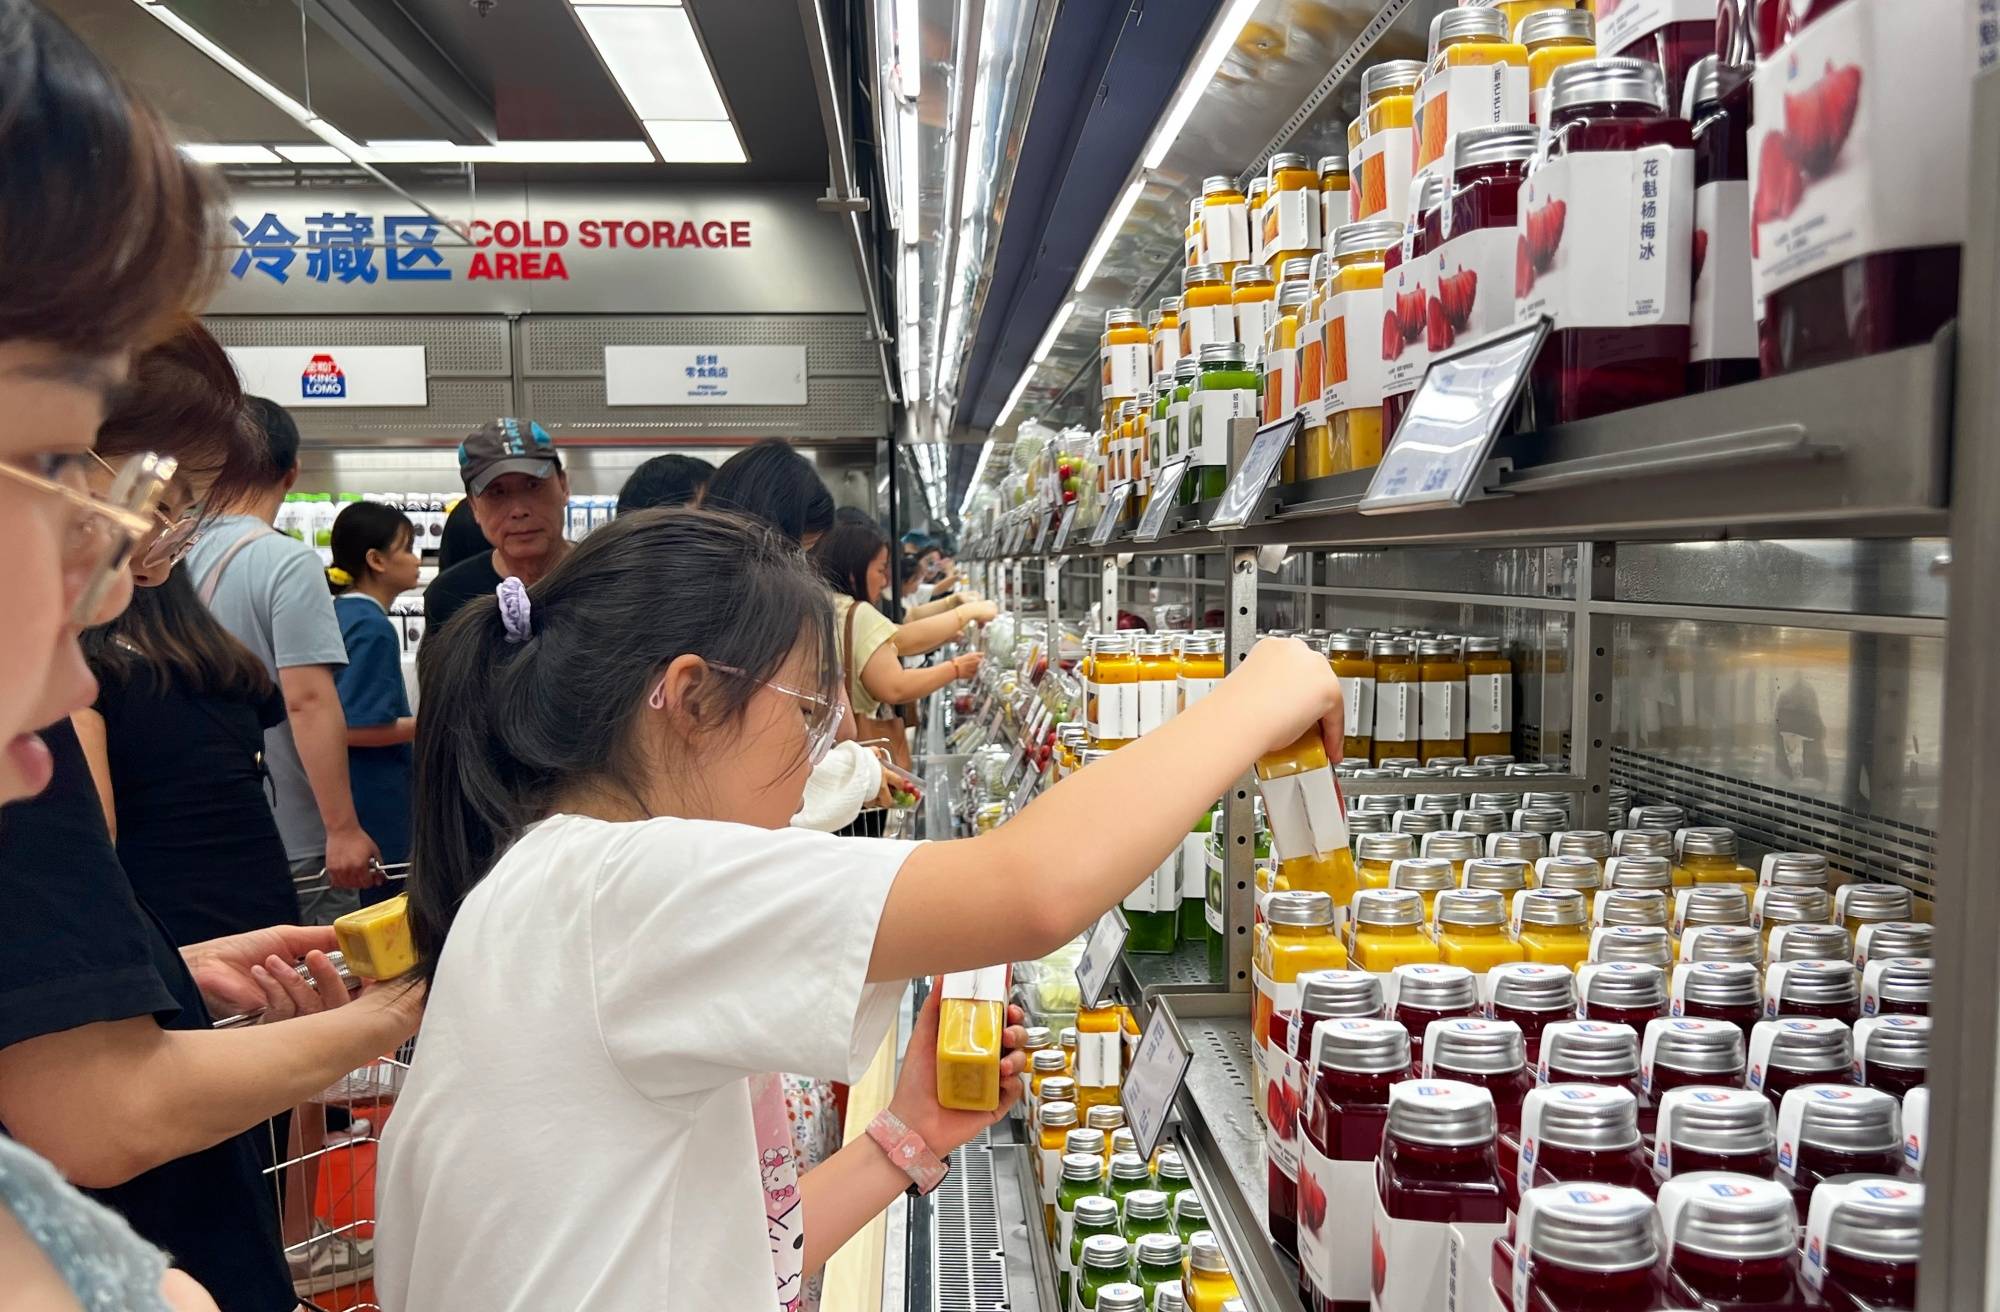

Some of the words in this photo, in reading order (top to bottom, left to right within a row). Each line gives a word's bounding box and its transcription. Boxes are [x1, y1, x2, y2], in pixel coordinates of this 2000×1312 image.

[1639, 159, 1659, 260] 花魁杨梅冰
[228, 212, 452, 284] 冷藏区
[471, 220, 569, 248] COLD
[578, 220, 752, 248] STORAGE
[468, 252, 569, 281] AREA
[306, 383, 342, 395] LOMO
[309, 374, 338, 384] KING
